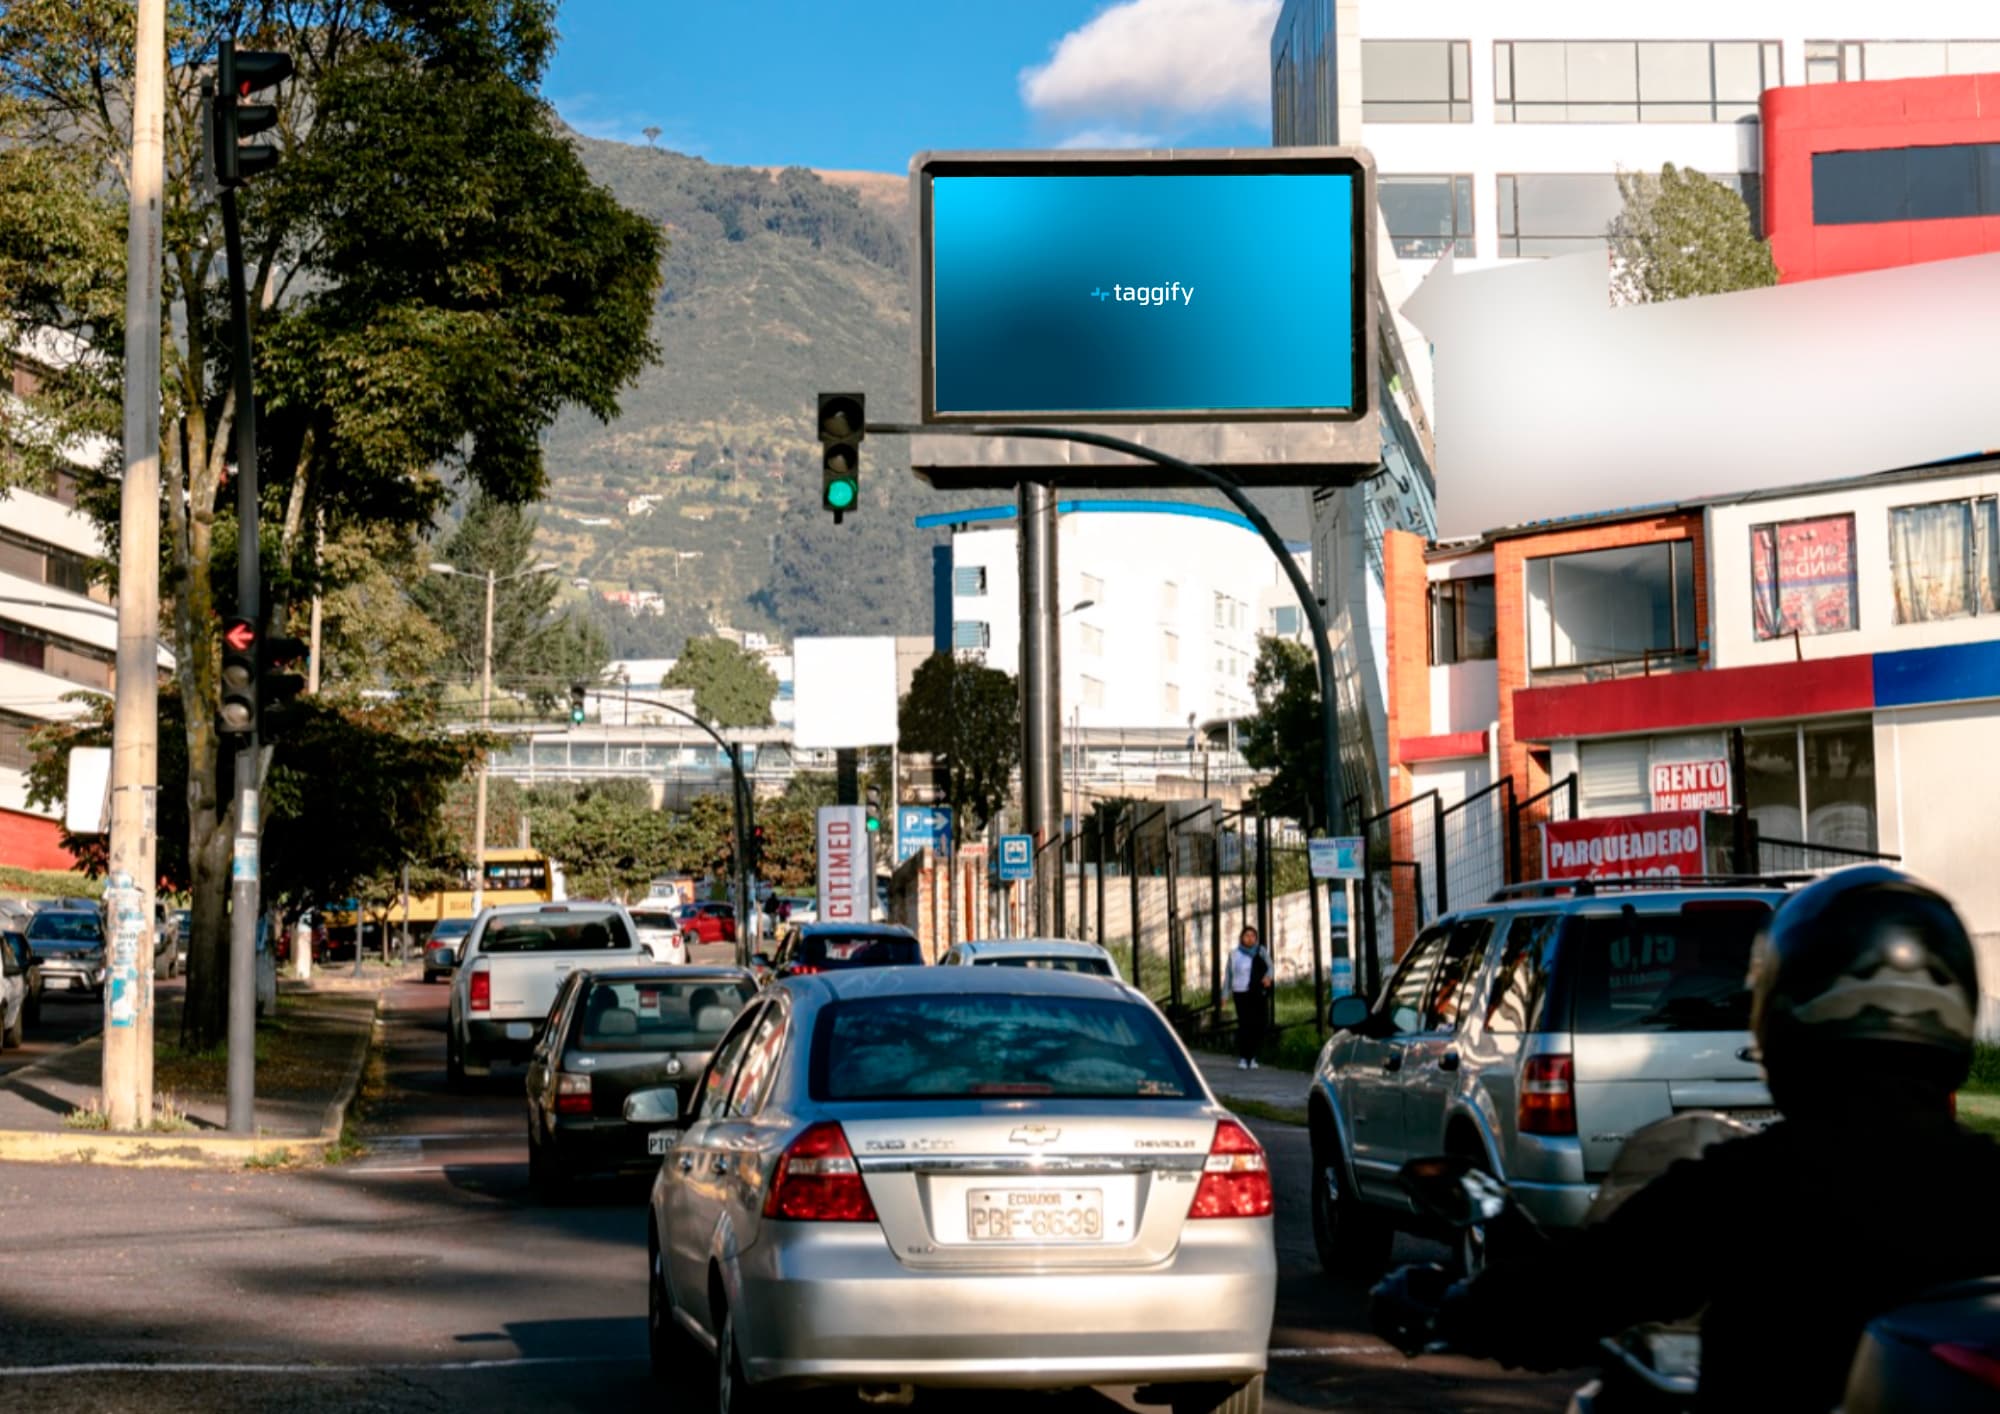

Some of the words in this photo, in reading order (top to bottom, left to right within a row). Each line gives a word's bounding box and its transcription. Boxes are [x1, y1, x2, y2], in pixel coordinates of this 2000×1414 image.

[1113, 281, 1194, 306] taggify
[1655, 762, 1725, 791] RENTO
[905, 814, 918, 829] P
[1551, 826, 1698, 868] PARQUEADERO
[828, 821, 853, 918] CITIMED
